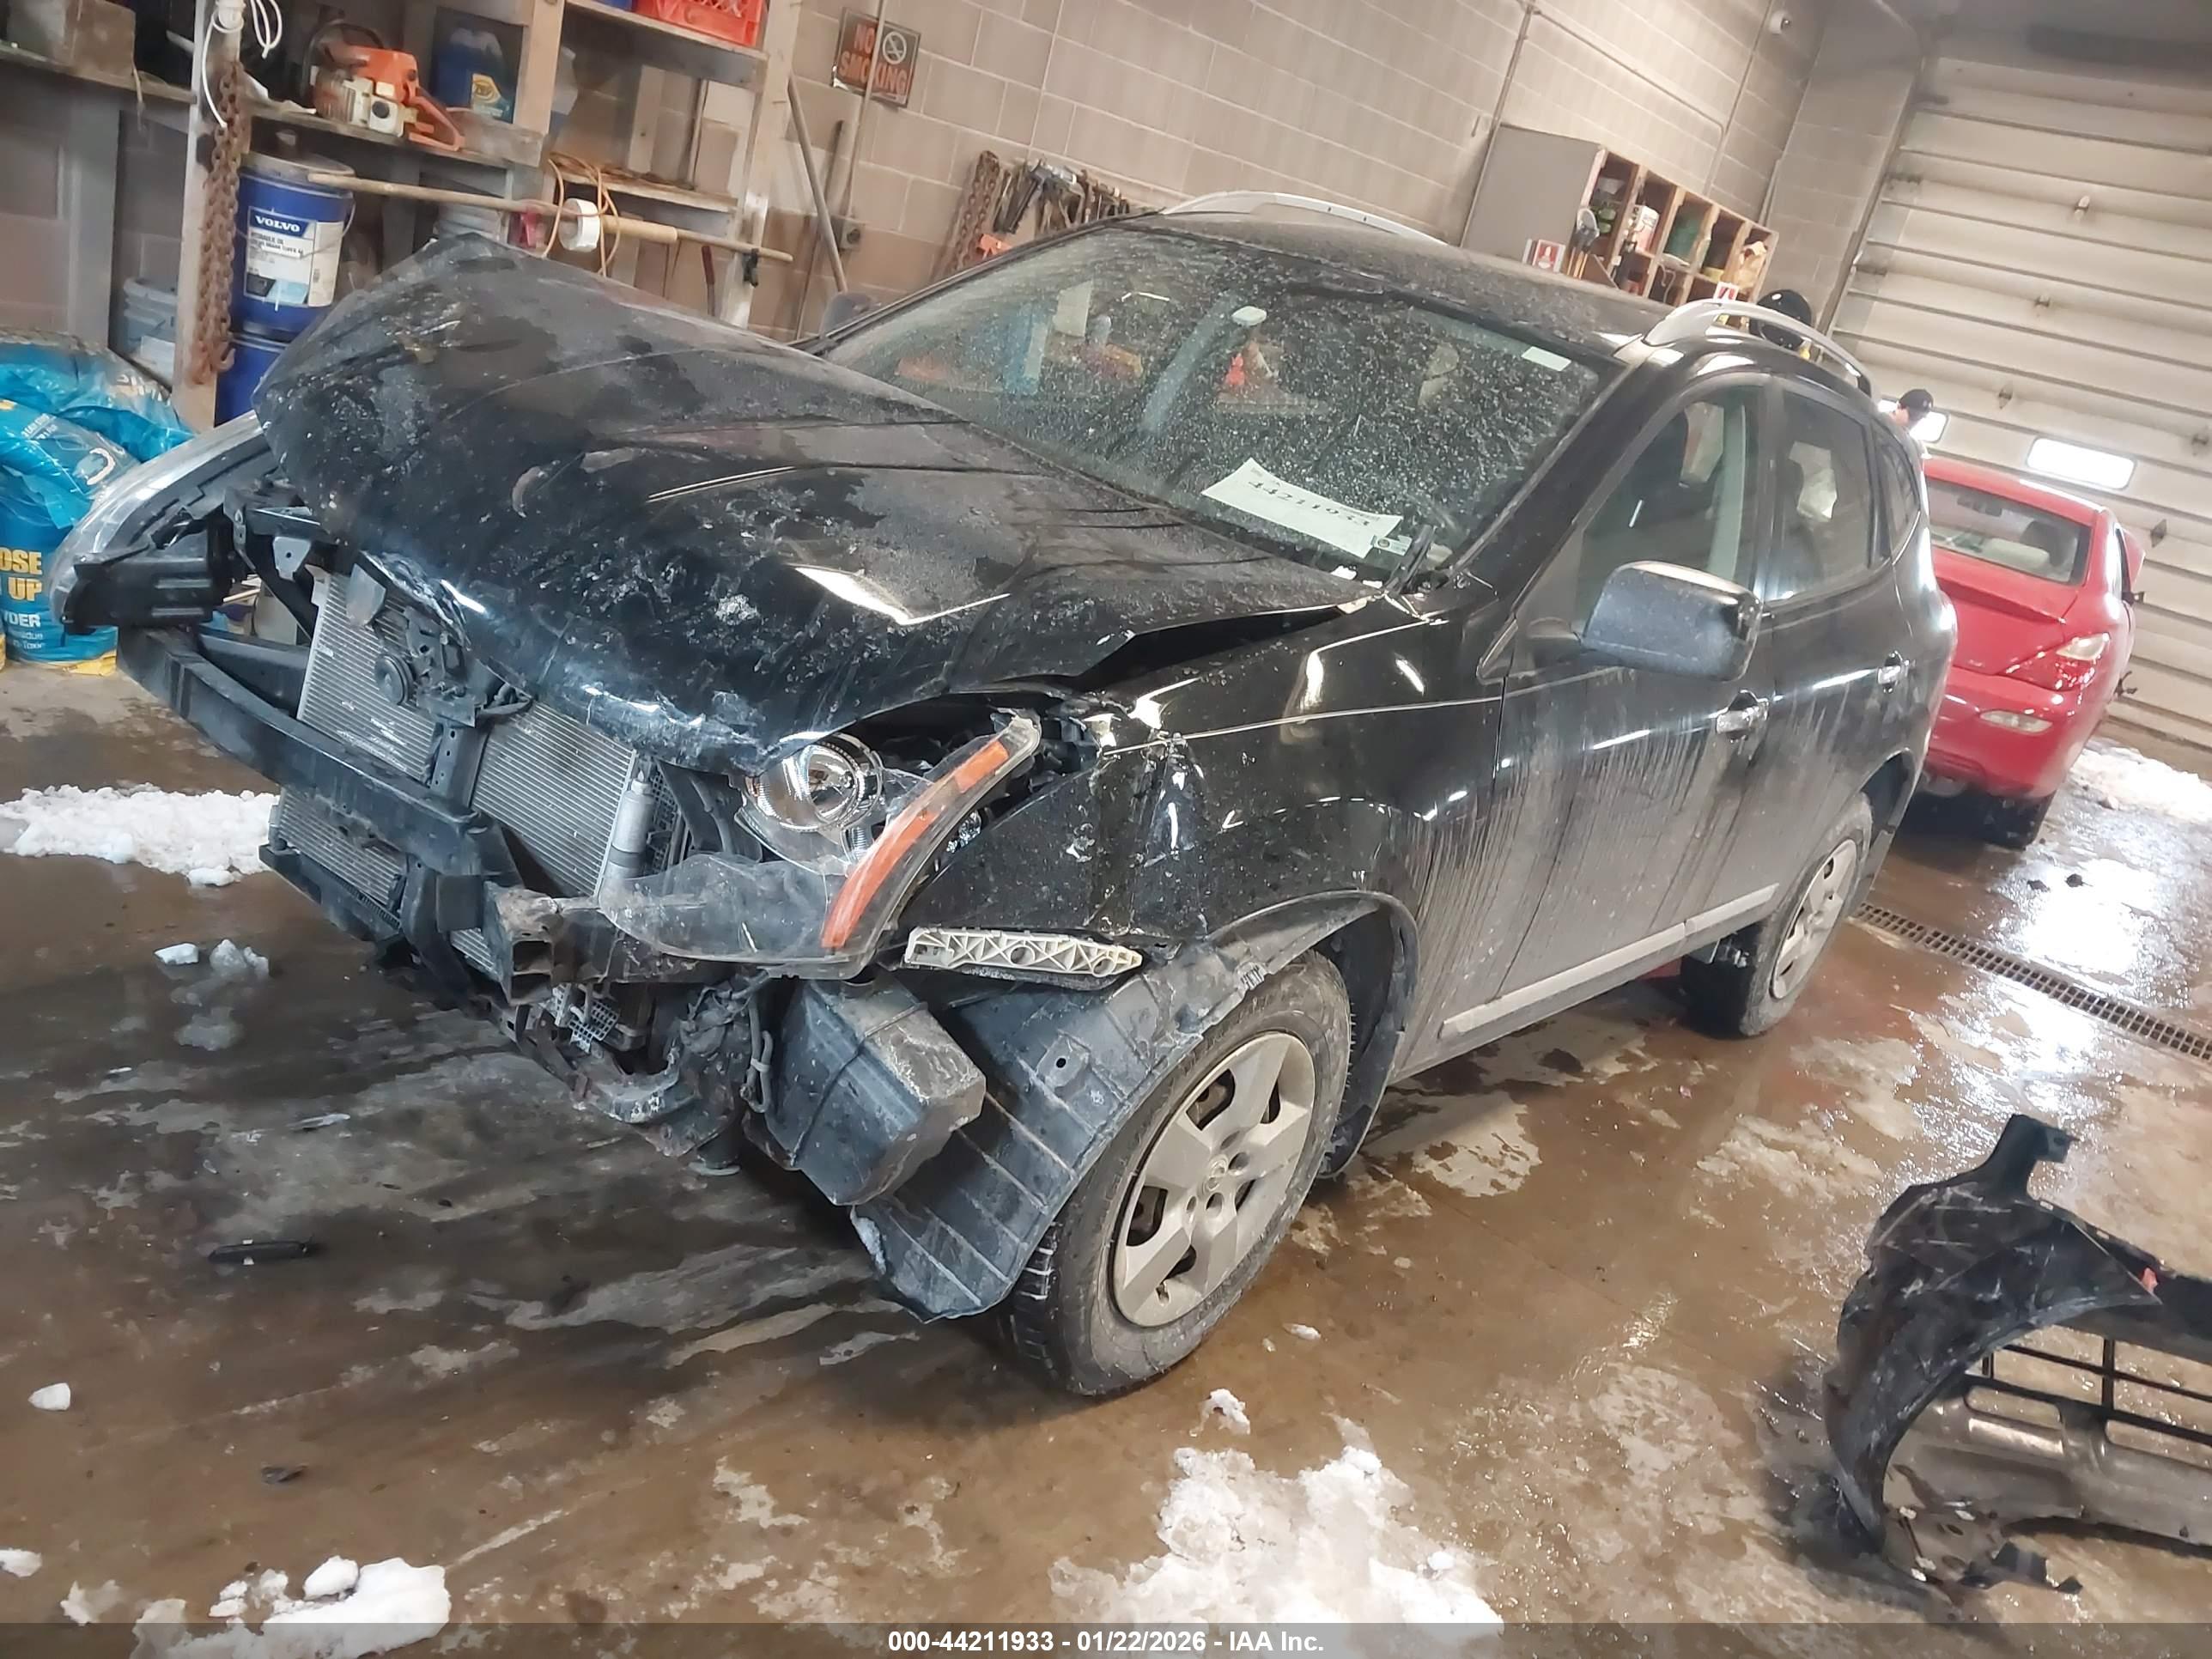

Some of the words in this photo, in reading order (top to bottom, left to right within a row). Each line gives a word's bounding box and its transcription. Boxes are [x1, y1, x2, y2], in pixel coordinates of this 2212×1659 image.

[854, 23, 875, 54] NO
[255, 214, 301, 233] VOLVO
[8, 576, 42, 601] UP
